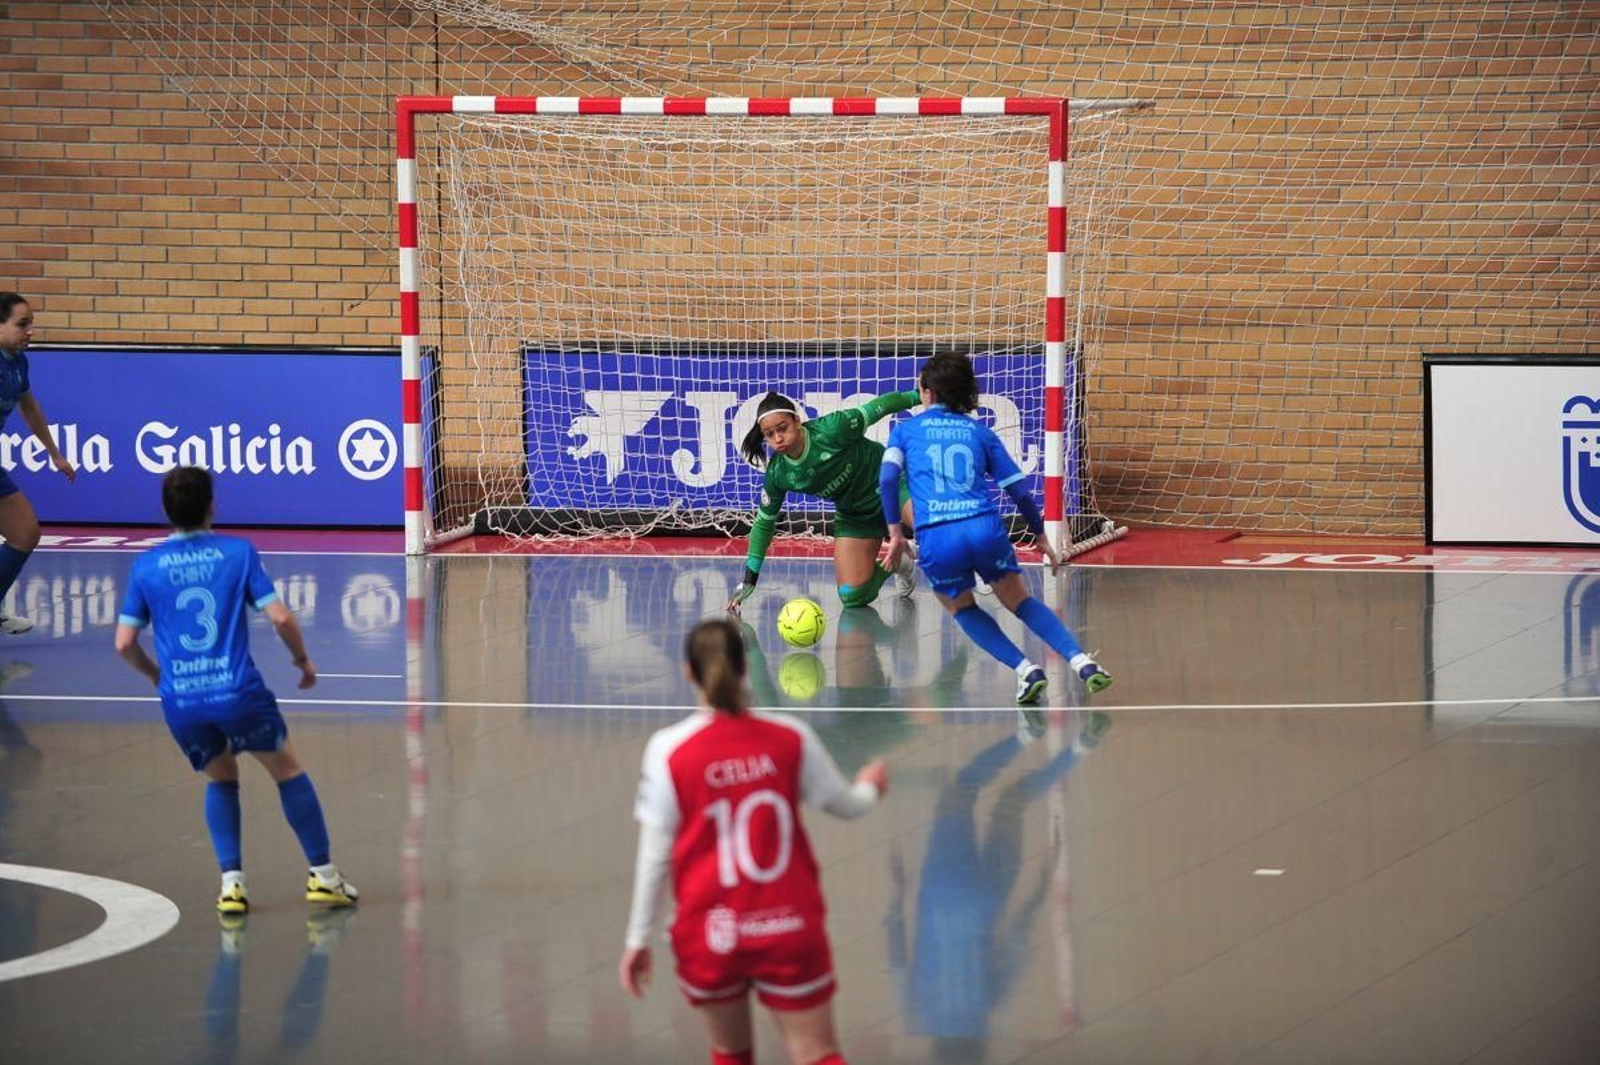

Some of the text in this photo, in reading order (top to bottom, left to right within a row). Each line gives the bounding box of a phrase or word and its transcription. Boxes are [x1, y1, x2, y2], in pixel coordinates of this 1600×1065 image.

[921, 417, 976, 429] ABANCA
[135, 421, 316, 475] Galicia
[925, 443, 975, 493] 10
[928, 498, 980, 512] Ontime
[157, 547, 225, 569] ABANCA
[175, 586, 219, 653] 3
[705, 754, 777, 787] CELIA
[705, 790, 793, 887] 10
